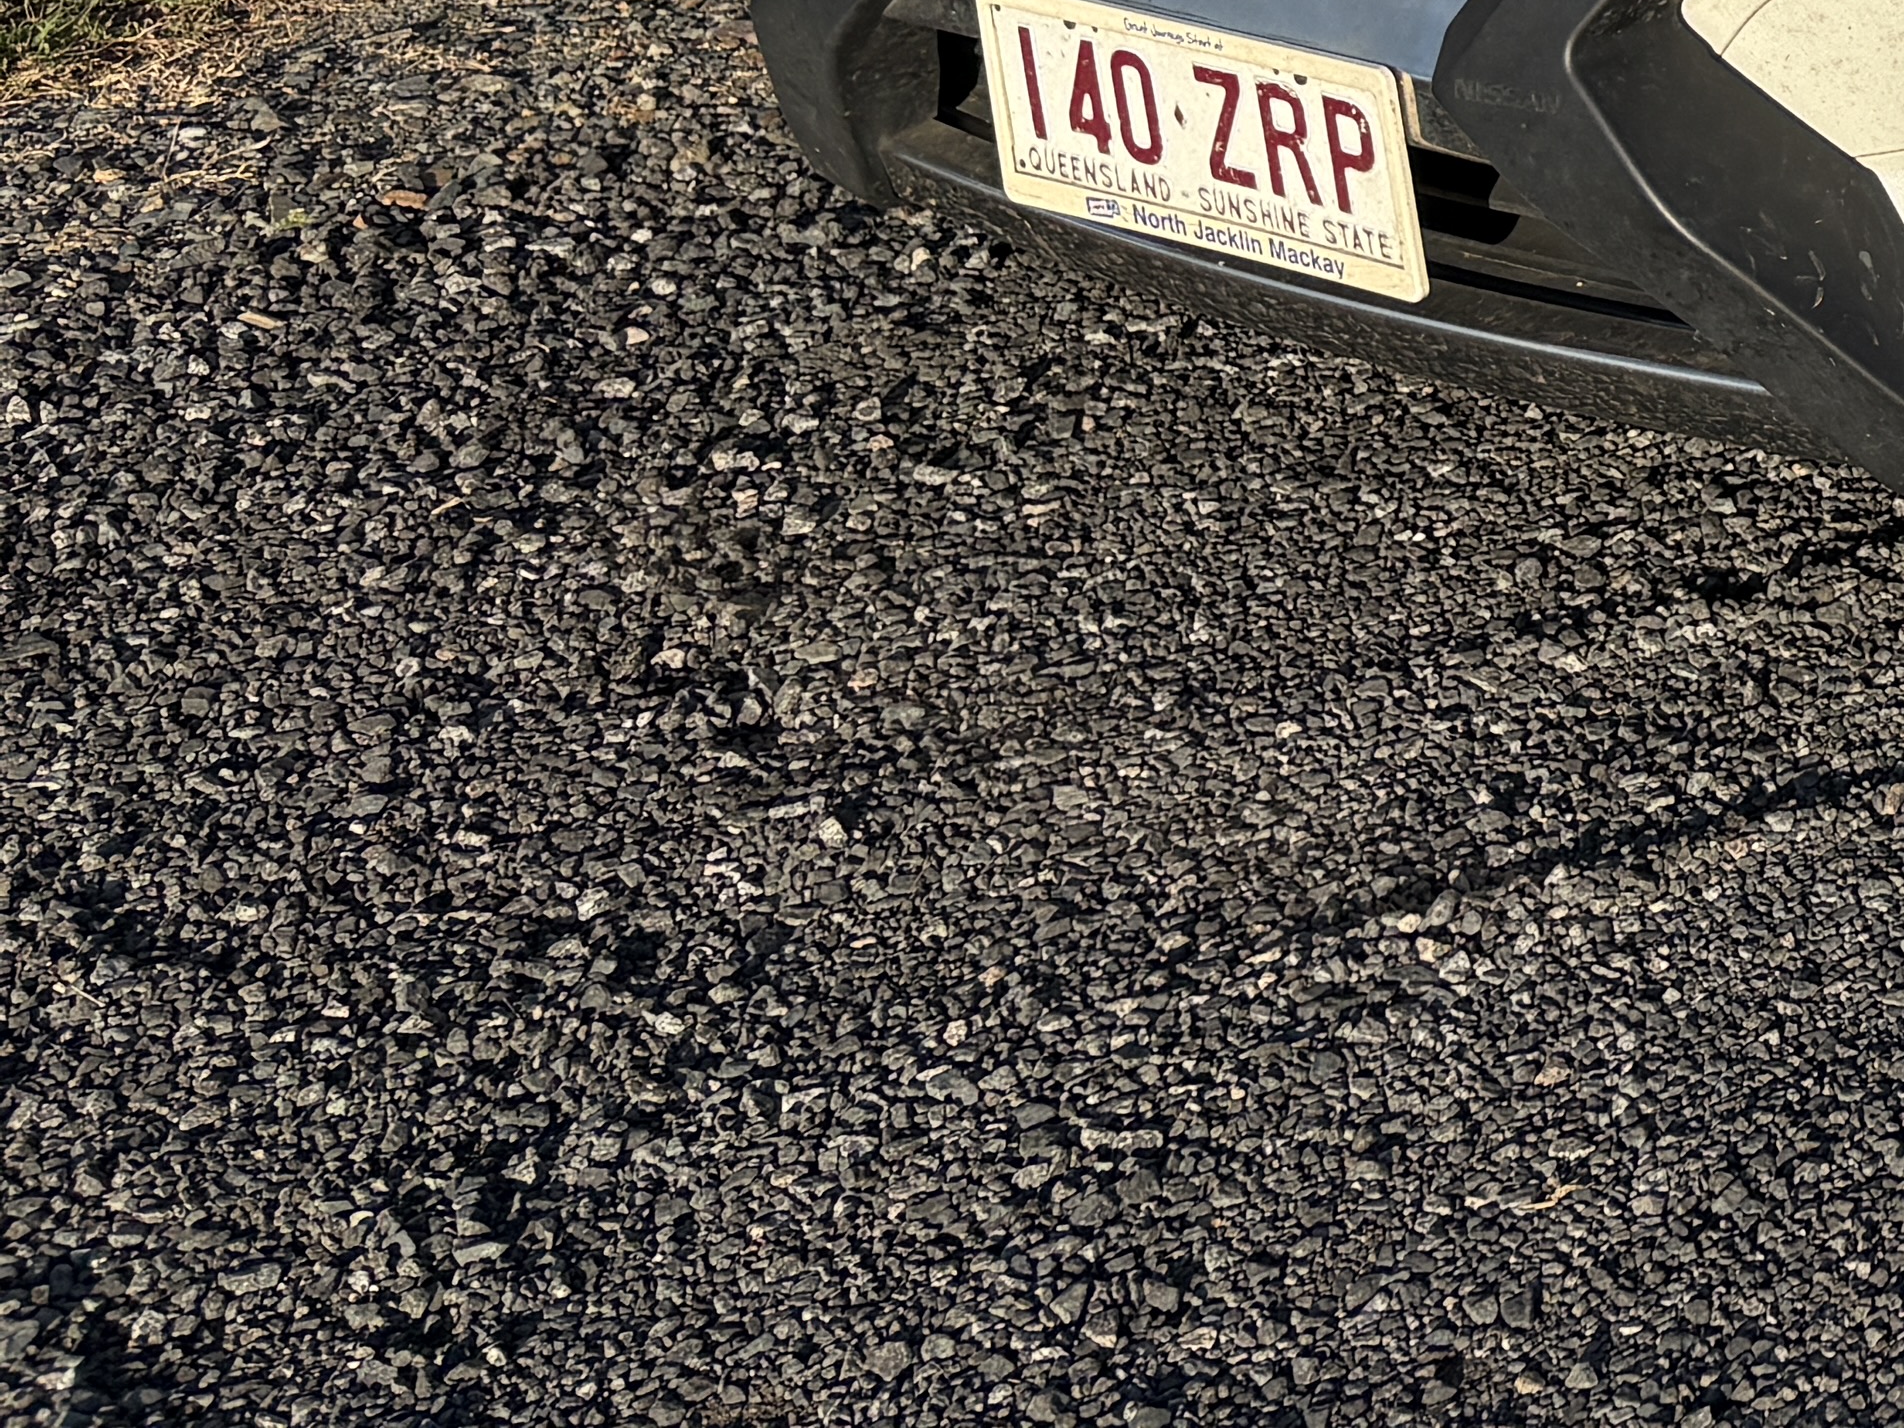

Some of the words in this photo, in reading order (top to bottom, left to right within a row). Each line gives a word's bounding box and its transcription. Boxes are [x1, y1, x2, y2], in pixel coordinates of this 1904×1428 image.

[1186, 32, 1211, 48] Start
[1192, 64, 1375, 214] ZRP
[1027, 146, 1172, 203] QUEENSLAND
[1198, 188, 1310, 239] SUNSHINE
[1322, 218, 1394, 260] STATE
[1132, 204, 1187, 236] North
[1194, 220, 1263, 255] Jacklin
[1270, 238, 1345, 279] Mackay
